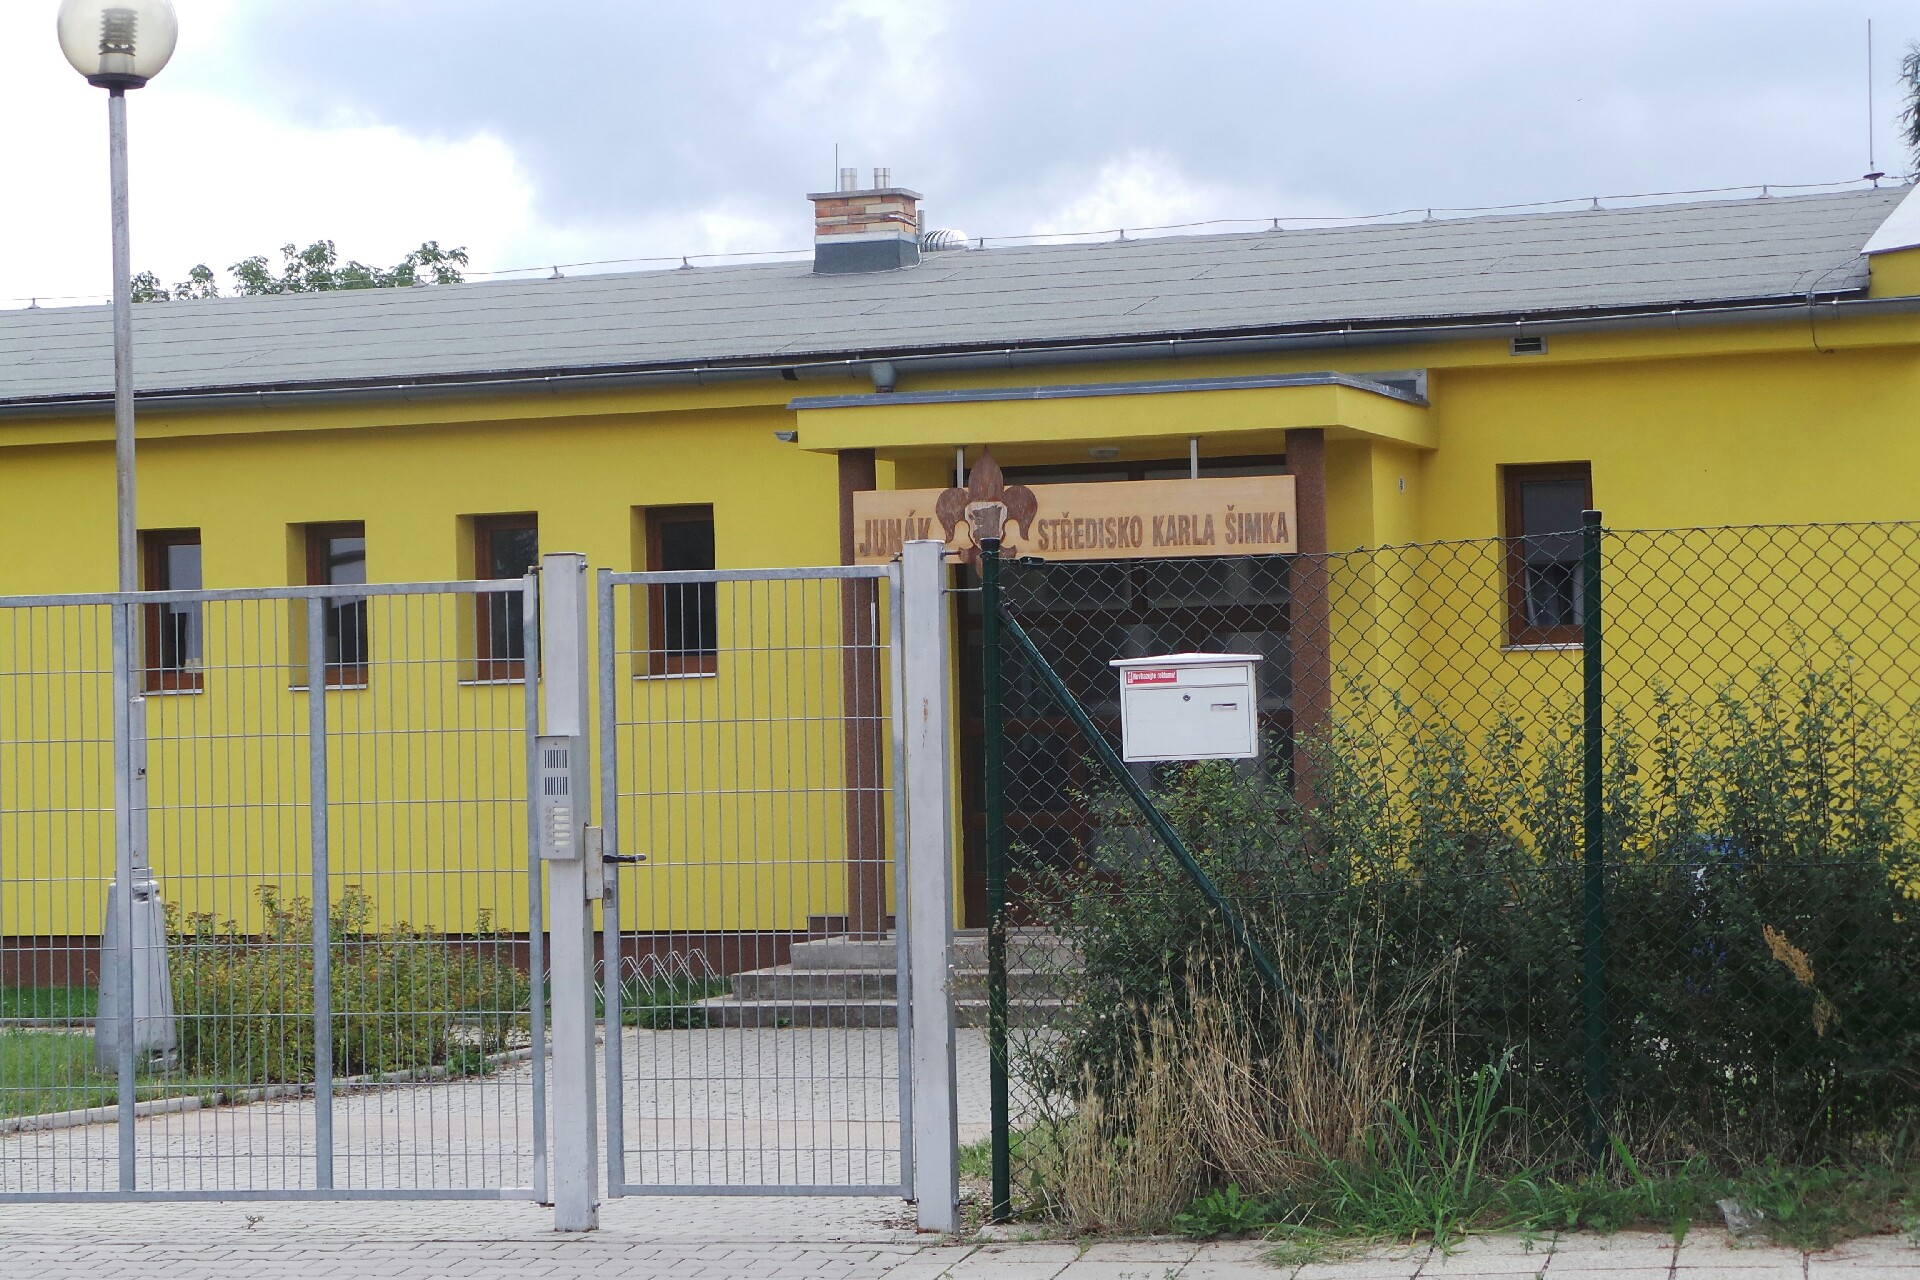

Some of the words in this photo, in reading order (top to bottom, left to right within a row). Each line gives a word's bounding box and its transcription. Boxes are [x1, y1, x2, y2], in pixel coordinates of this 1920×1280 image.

[859, 509, 932, 556] JUNÁK
[1037, 511, 1143, 551] STŘEDISKO
[1152, 513, 1216, 547] KARLA
[1224, 504, 1289, 545] ŠIMKA
